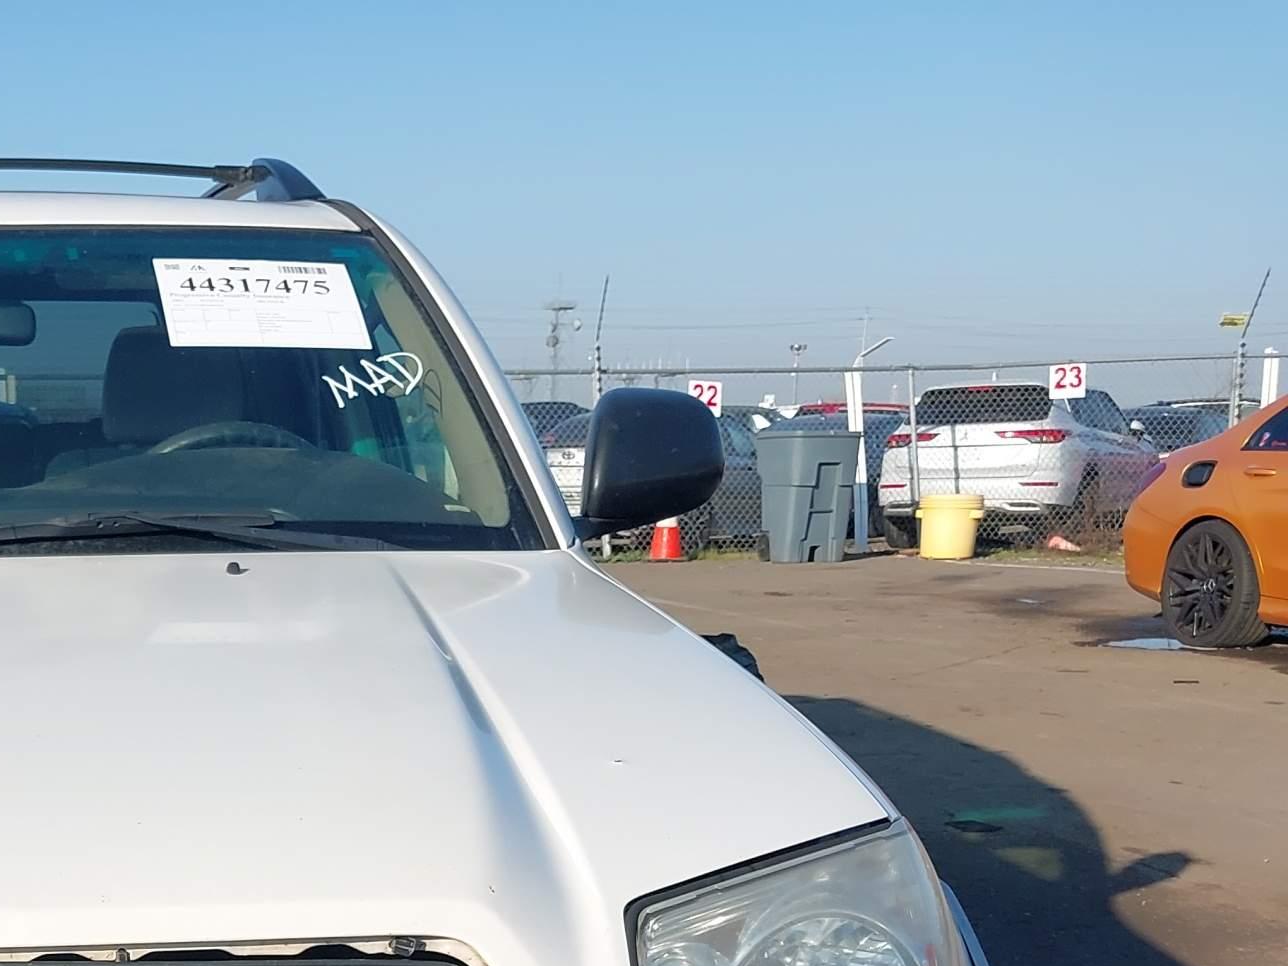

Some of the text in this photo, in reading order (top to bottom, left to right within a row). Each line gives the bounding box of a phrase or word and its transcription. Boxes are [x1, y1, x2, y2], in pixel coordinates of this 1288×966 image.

[180, 277, 330, 294] 44317475
[321, 351, 424, 409] MAD
[1054, 366, 1082, 390] 23
